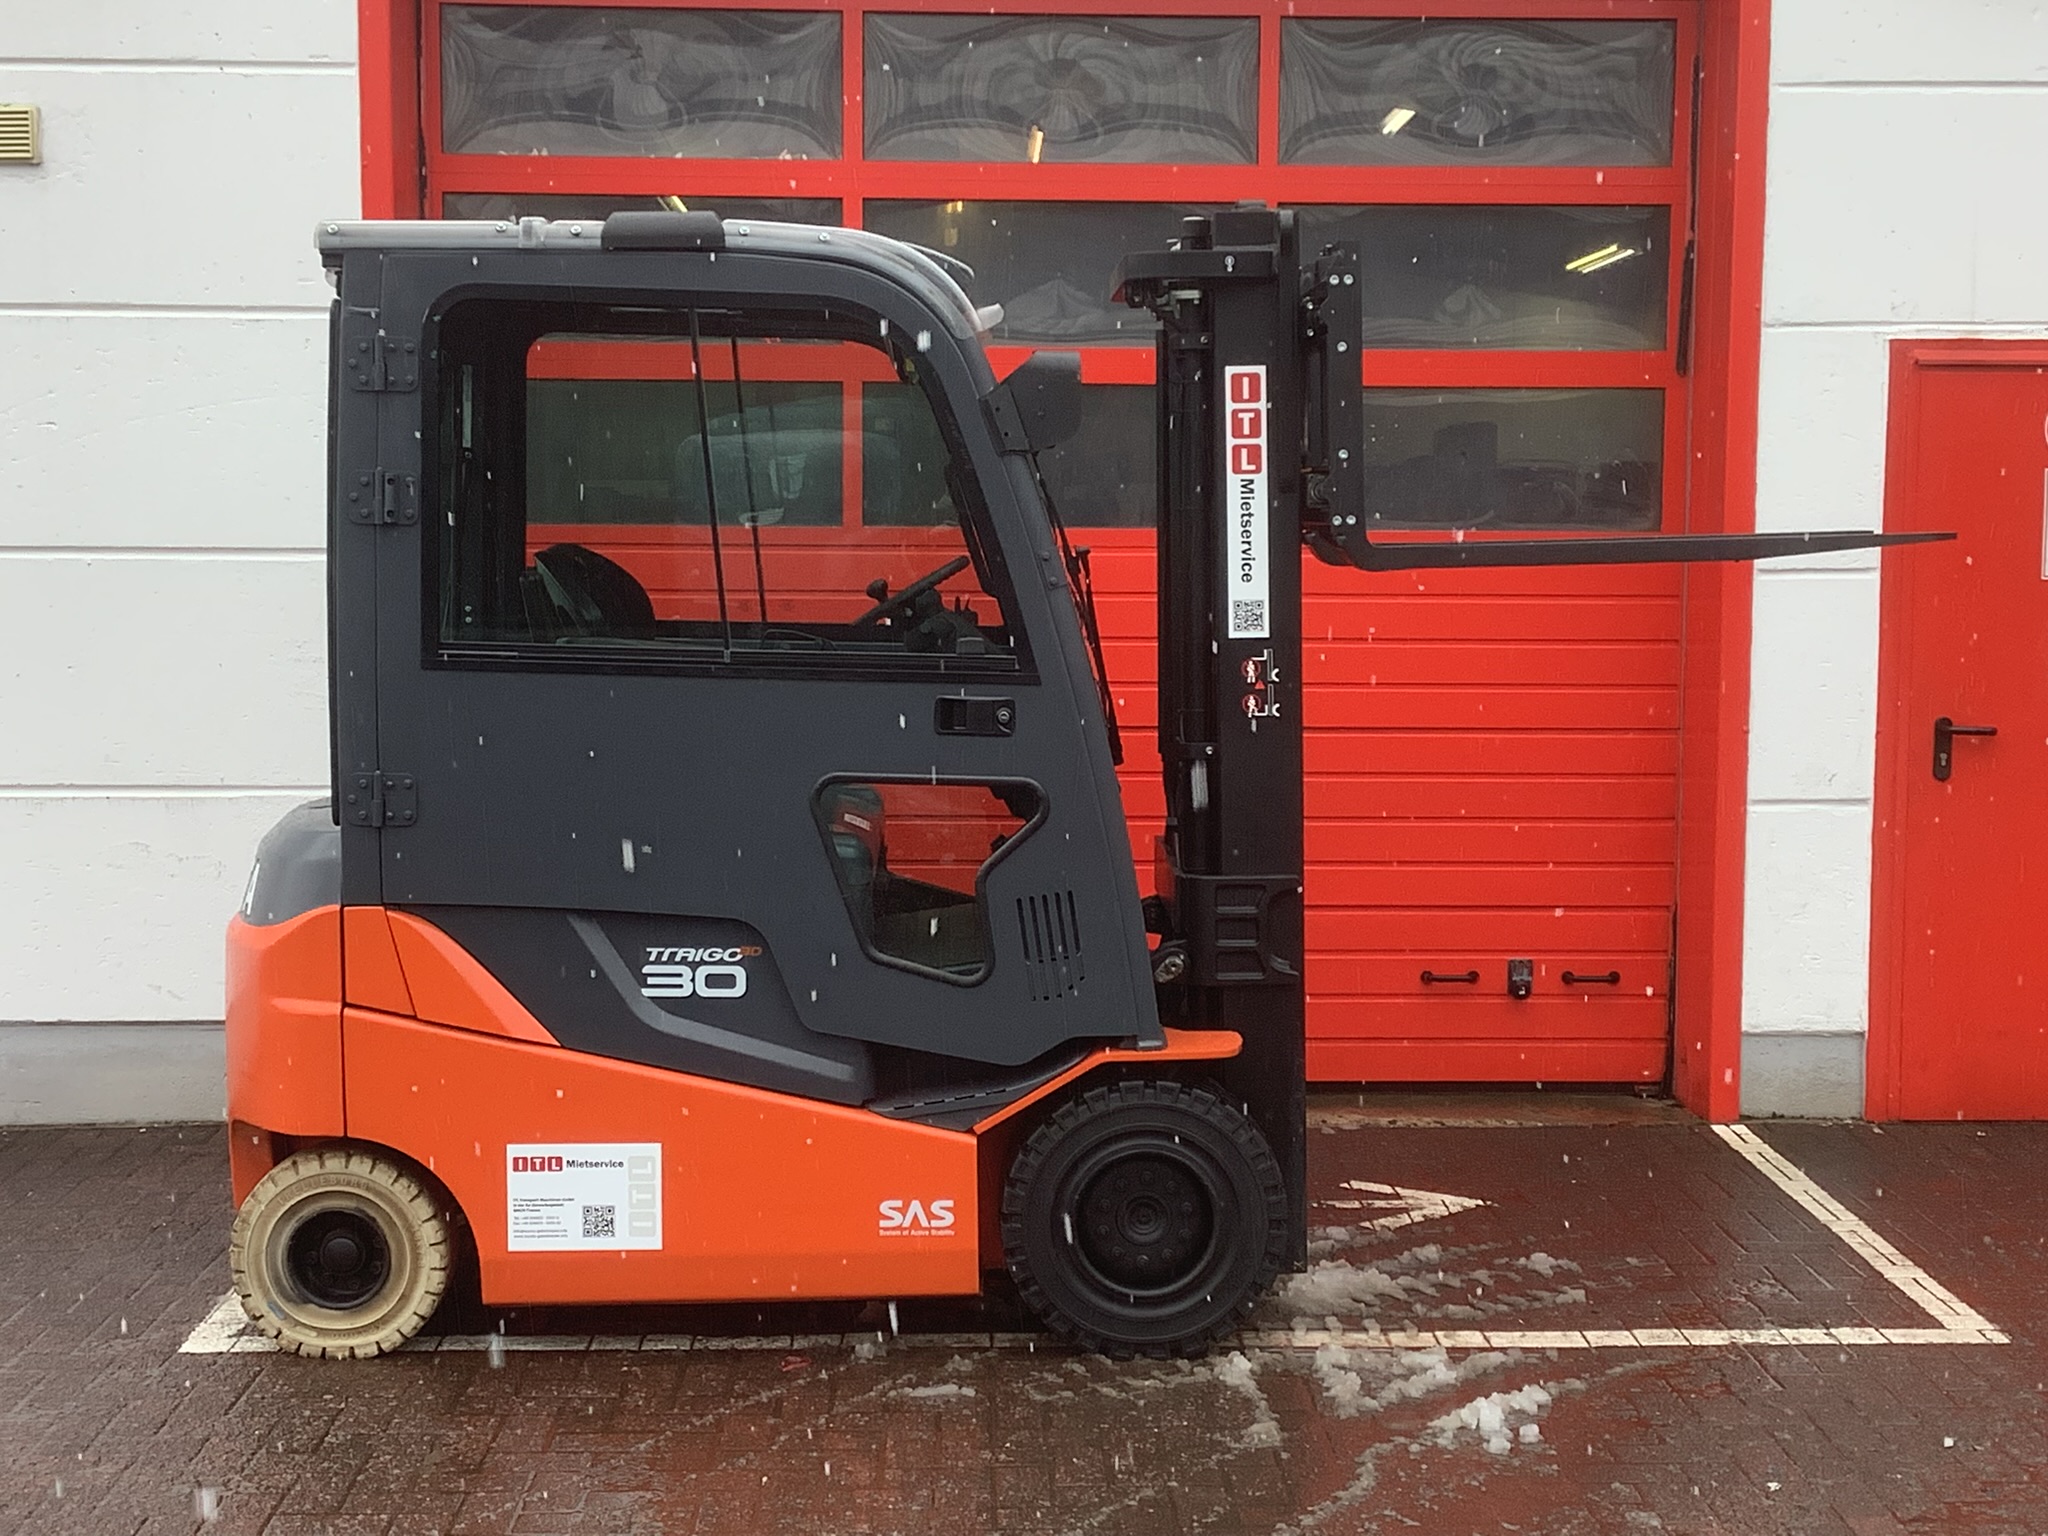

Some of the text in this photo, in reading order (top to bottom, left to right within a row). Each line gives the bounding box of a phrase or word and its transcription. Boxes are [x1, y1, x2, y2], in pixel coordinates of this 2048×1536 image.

[1234, 374, 1259, 584] ITL Mietservice
[641, 964, 747, 998] 30
[515, 1158, 624, 1171] ITL Mietservice
[878, 1199, 955, 1228] SAS
